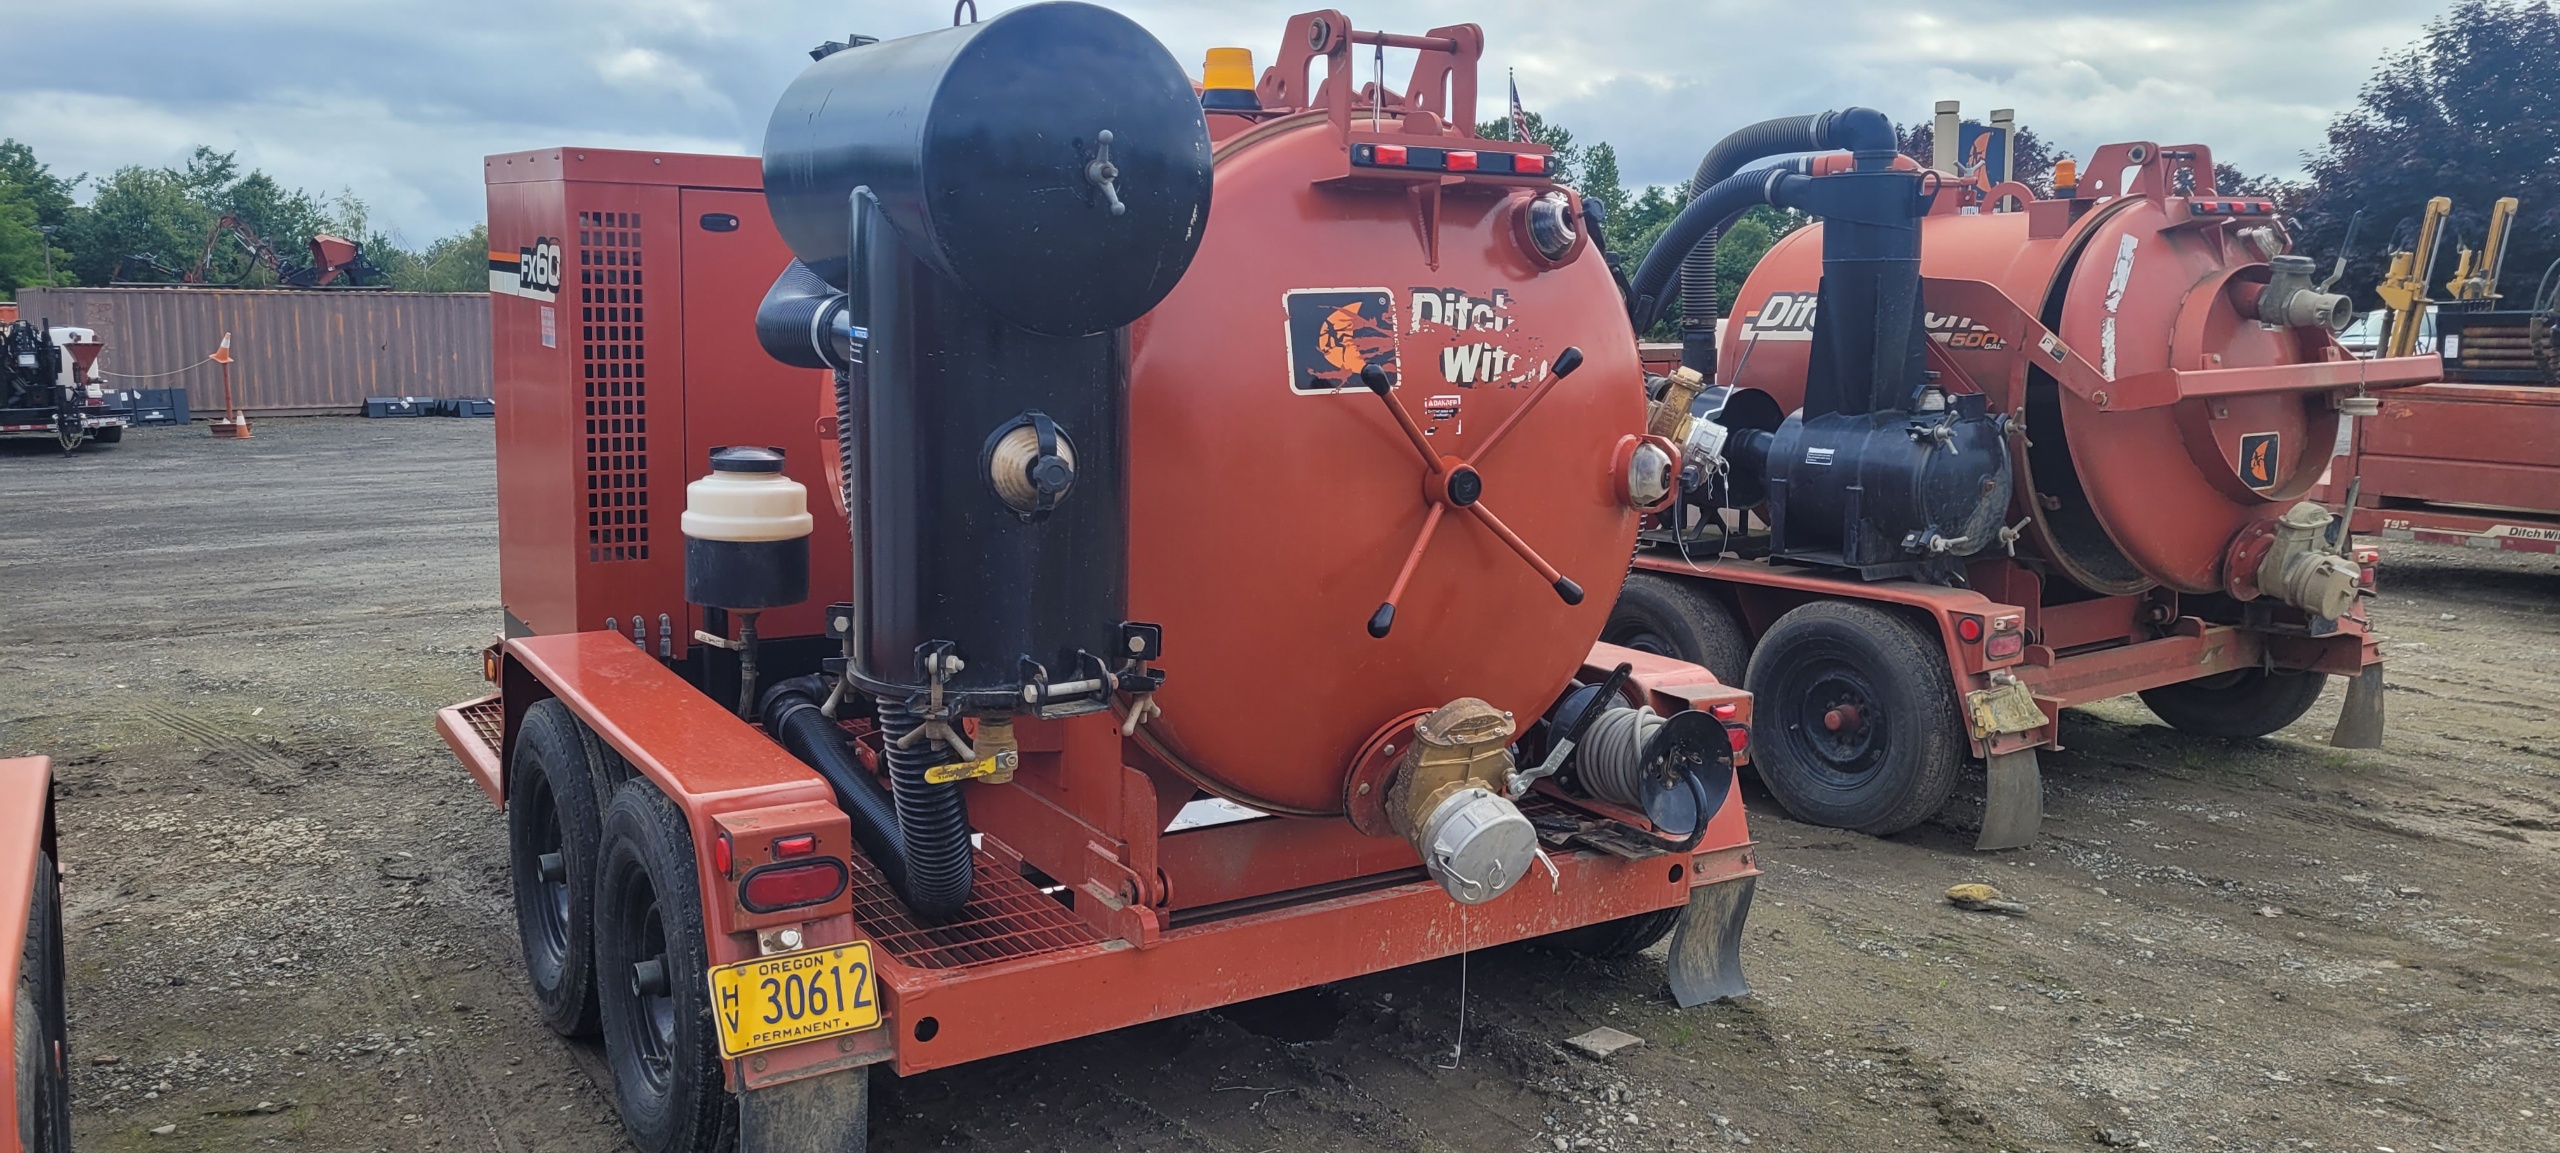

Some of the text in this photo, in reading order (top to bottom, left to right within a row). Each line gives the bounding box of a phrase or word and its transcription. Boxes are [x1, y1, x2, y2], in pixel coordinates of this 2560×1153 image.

[520, 243, 561, 287] FX60
[1756, 295, 1818, 328] Dit
[2509, 527, 2541, 538] Ditch
[758, 955, 824, 976] OREGON
[760, 961, 872, 1025] 30612
[753, 1018, 841, 1044] PERMANENT
